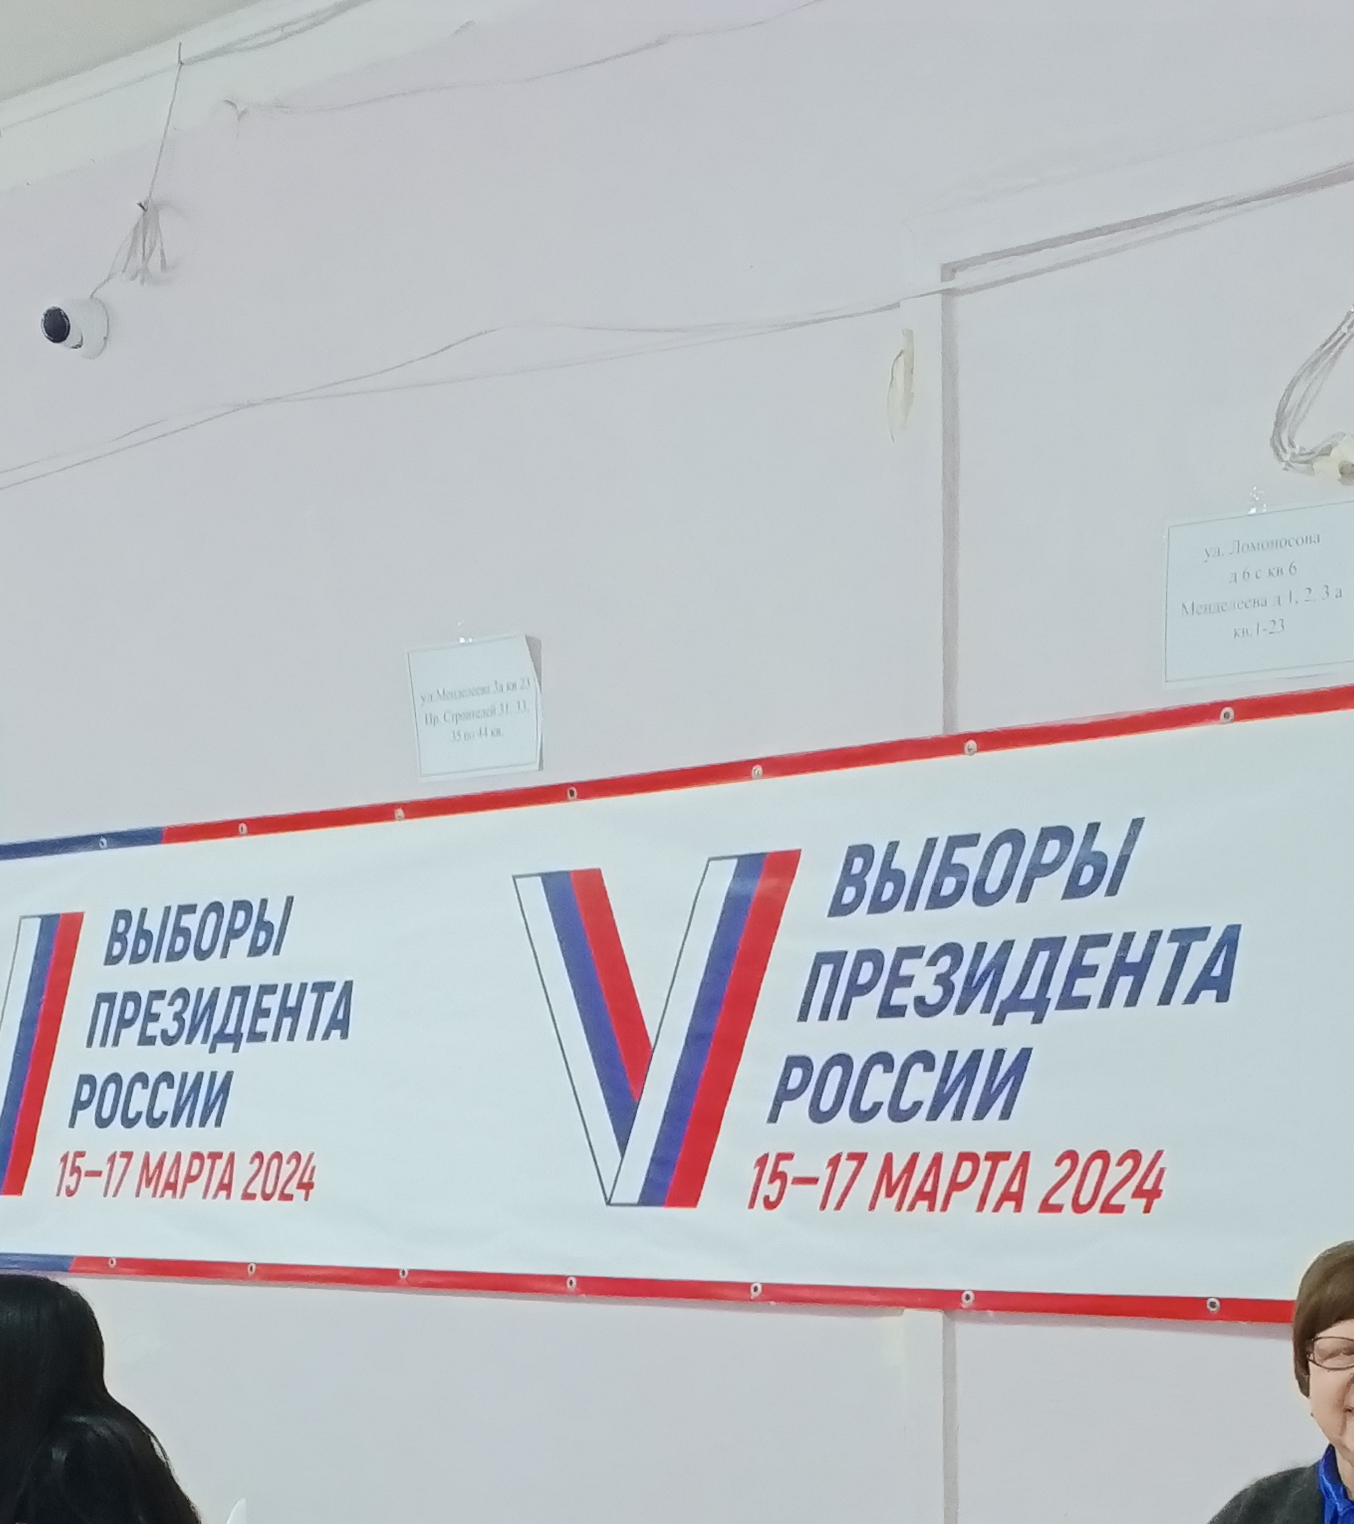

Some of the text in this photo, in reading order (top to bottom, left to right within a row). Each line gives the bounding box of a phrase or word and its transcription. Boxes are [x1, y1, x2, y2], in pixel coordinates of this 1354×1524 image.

[1229, 533, 1320, 555] Ломоносова
[1268, 566, 1284, 578] кв
[1288, 560, 1297, 576] 6
[1181, 595, 1268, 617] Менделеева
[827, 817, 1145, 918] ВЫБОРЫ
[103, 895, 295, 966] ВЫБОРЫ
[796, 923, 1242, 1026] ПРЕЗИДЕНТА
[85, 980, 354, 1054] ПРЕЗИДЕНТА
[68, 1070, 234, 1129] РОССИИ
[766, 1047, 1034, 1125] РОССИИ
[56, 1150, 316, 1201] 15–17 МАРТА 2024
[746, 1149, 1166, 1214] 15–17 МАРТА 2024
